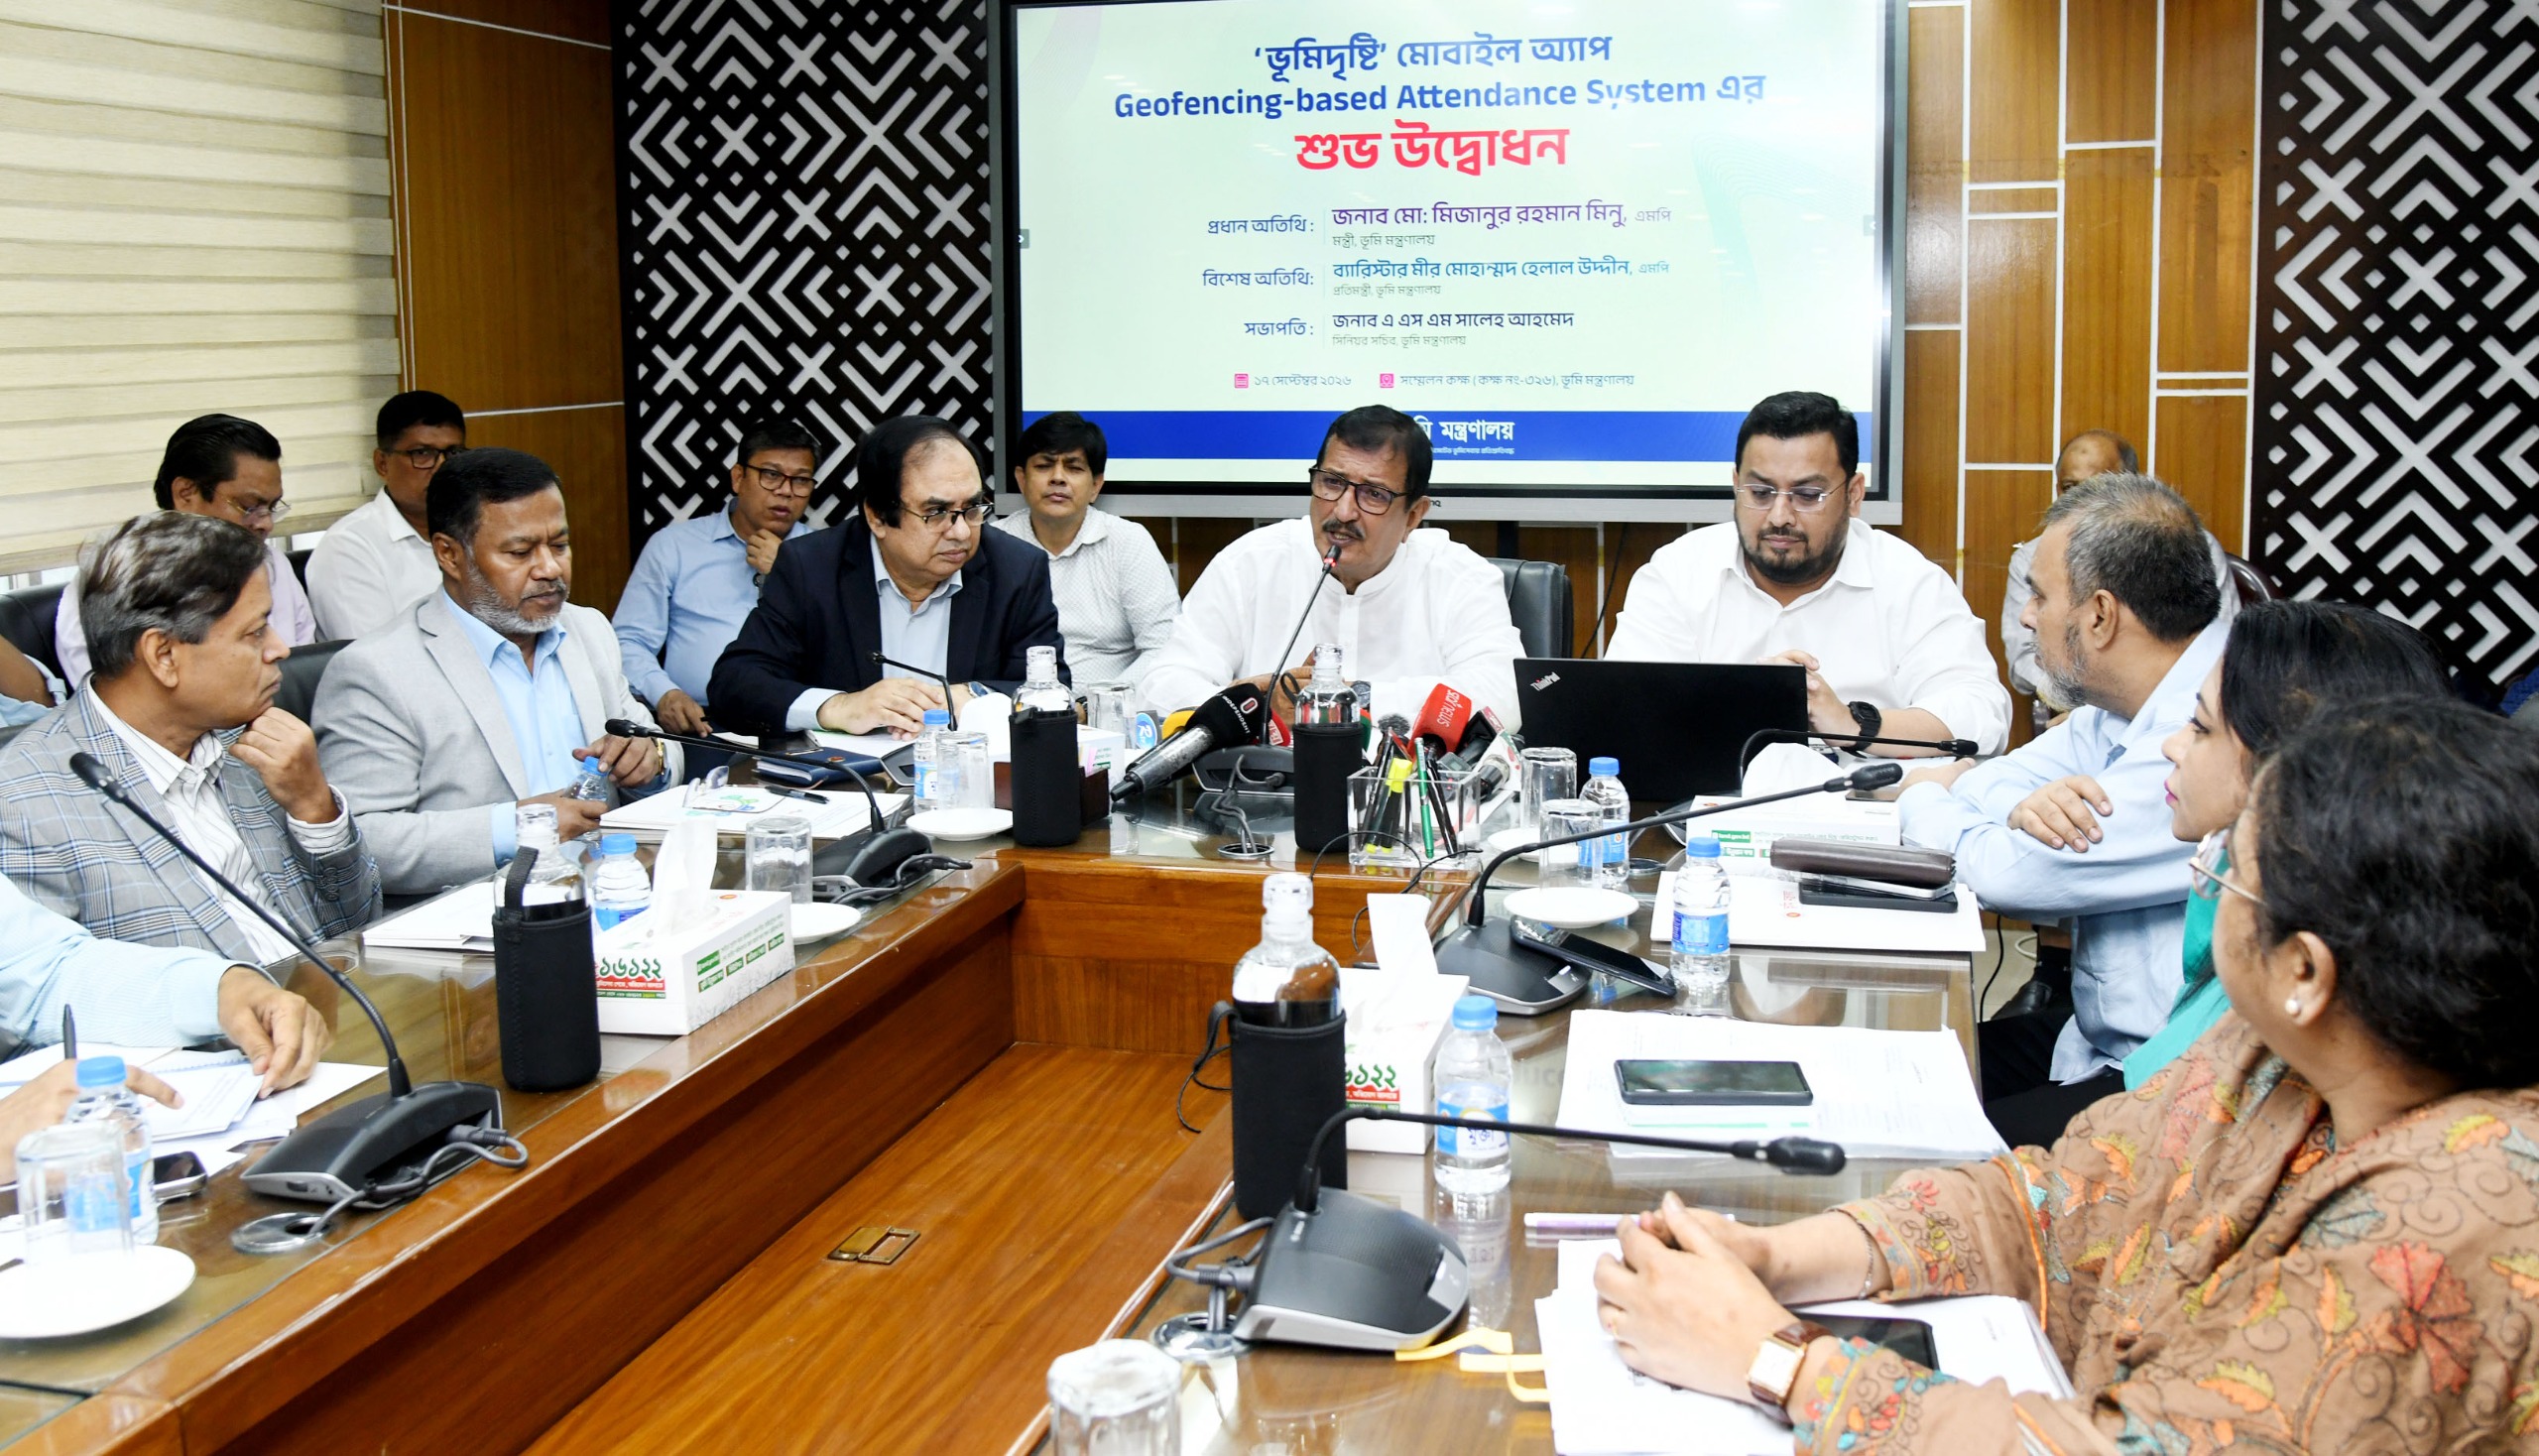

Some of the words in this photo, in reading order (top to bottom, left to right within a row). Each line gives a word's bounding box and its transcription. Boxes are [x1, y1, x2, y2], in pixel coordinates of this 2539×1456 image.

[1397, 31, 1522, 66] মোবাইল
[1528, 36, 1613, 61] অ্যাপ
[1115, 85, 1387, 119] Geofencing-based
[1396, 82, 1577, 109] Attendance
[1586, 78, 1706, 110] System
[1716, 74, 1766, 104] এর
[1294, 133, 1383, 170] শুভ
[1390, 118, 1570, 177] উদ্বোধন
[1331, 208, 1390, 225] জনাব
[1431, 201, 1512, 230] মিজানুর
[1515, 205, 1582, 225] রহমান
[1585, 198, 1628, 228] মিনু,
[1634, 207, 1672, 222] এমপি
[1207, 219, 1249, 234] প্রধান
[1360, 233, 1383, 250] ভূমি
[1386, 234, 1435, 248] মন্ত্রণালয়
[1333, 259, 1408, 279] ব্যারিস্টার
[1411, 258, 1441, 279] মীর
[1445, 262, 1517, 278] মোহাম্মদ
[1521, 261, 1574, 277] হেলাল
[1577, 255, 1632, 276] উদ্দীন,
[1637, 260, 1669, 274] এমপি
[1202, 269, 1251, 287] বিশেষ
[1376, 283, 1394, 299] ভূমি
[1244, 317, 1307, 335] সভাপতি
[1332, 314, 1379, 327] জনাব
[1382, 313, 1393, 327] এ
[1397, 313, 1423, 327] এস
[1426, 313, 1453, 327] এম
[1455, 313, 1505, 328] সালেহ
[1508, 312, 1575, 328] আহমেদ
[1400, 333, 1420, 349] ভূমি
[1254, 376, 1270, 386] ১৭
[1271, 373, 1318, 387] সেপ্টেম্বর
[1320, 376, 1352, 386] ২০২৬
[1399, 375, 1444, 387] সম্মেলন
[1445, 374, 1471, 386] কক্ষ
[1560, 372, 1583, 389] ভূমি
[1586, 375, 1635, 388] মন্ত্রণালয়
[1438, 419, 1515, 443] মন্ত্রণালয়
[1529, 671, 1561, 691] ThinkPad
[1222, 695, 1251, 734] INDEPENDENT
[599, 956, 662, 979] ১৬১২২
